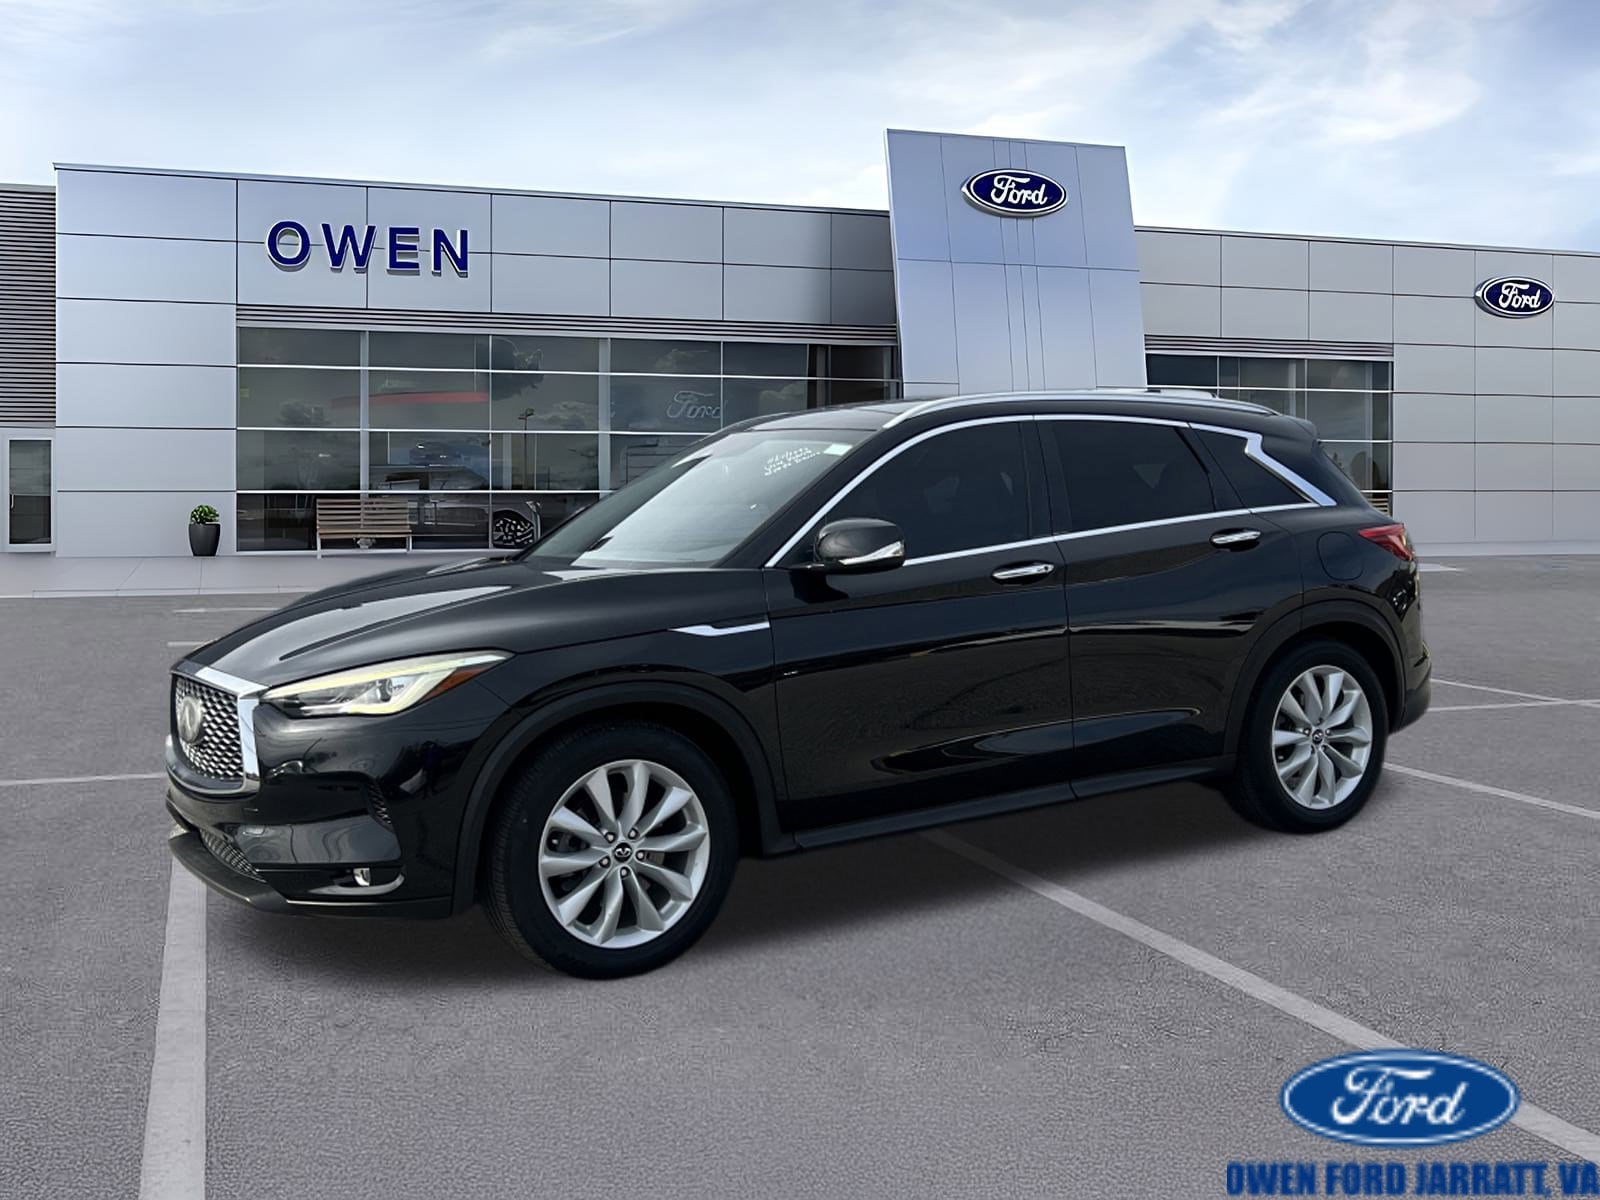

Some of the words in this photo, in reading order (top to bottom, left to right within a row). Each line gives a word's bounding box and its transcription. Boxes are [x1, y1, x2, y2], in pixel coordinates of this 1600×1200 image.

[990, 174, 1048, 204] Ford
[266, 219, 469, 277] OWEN
[1498, 282, 1541, 308] Ford
